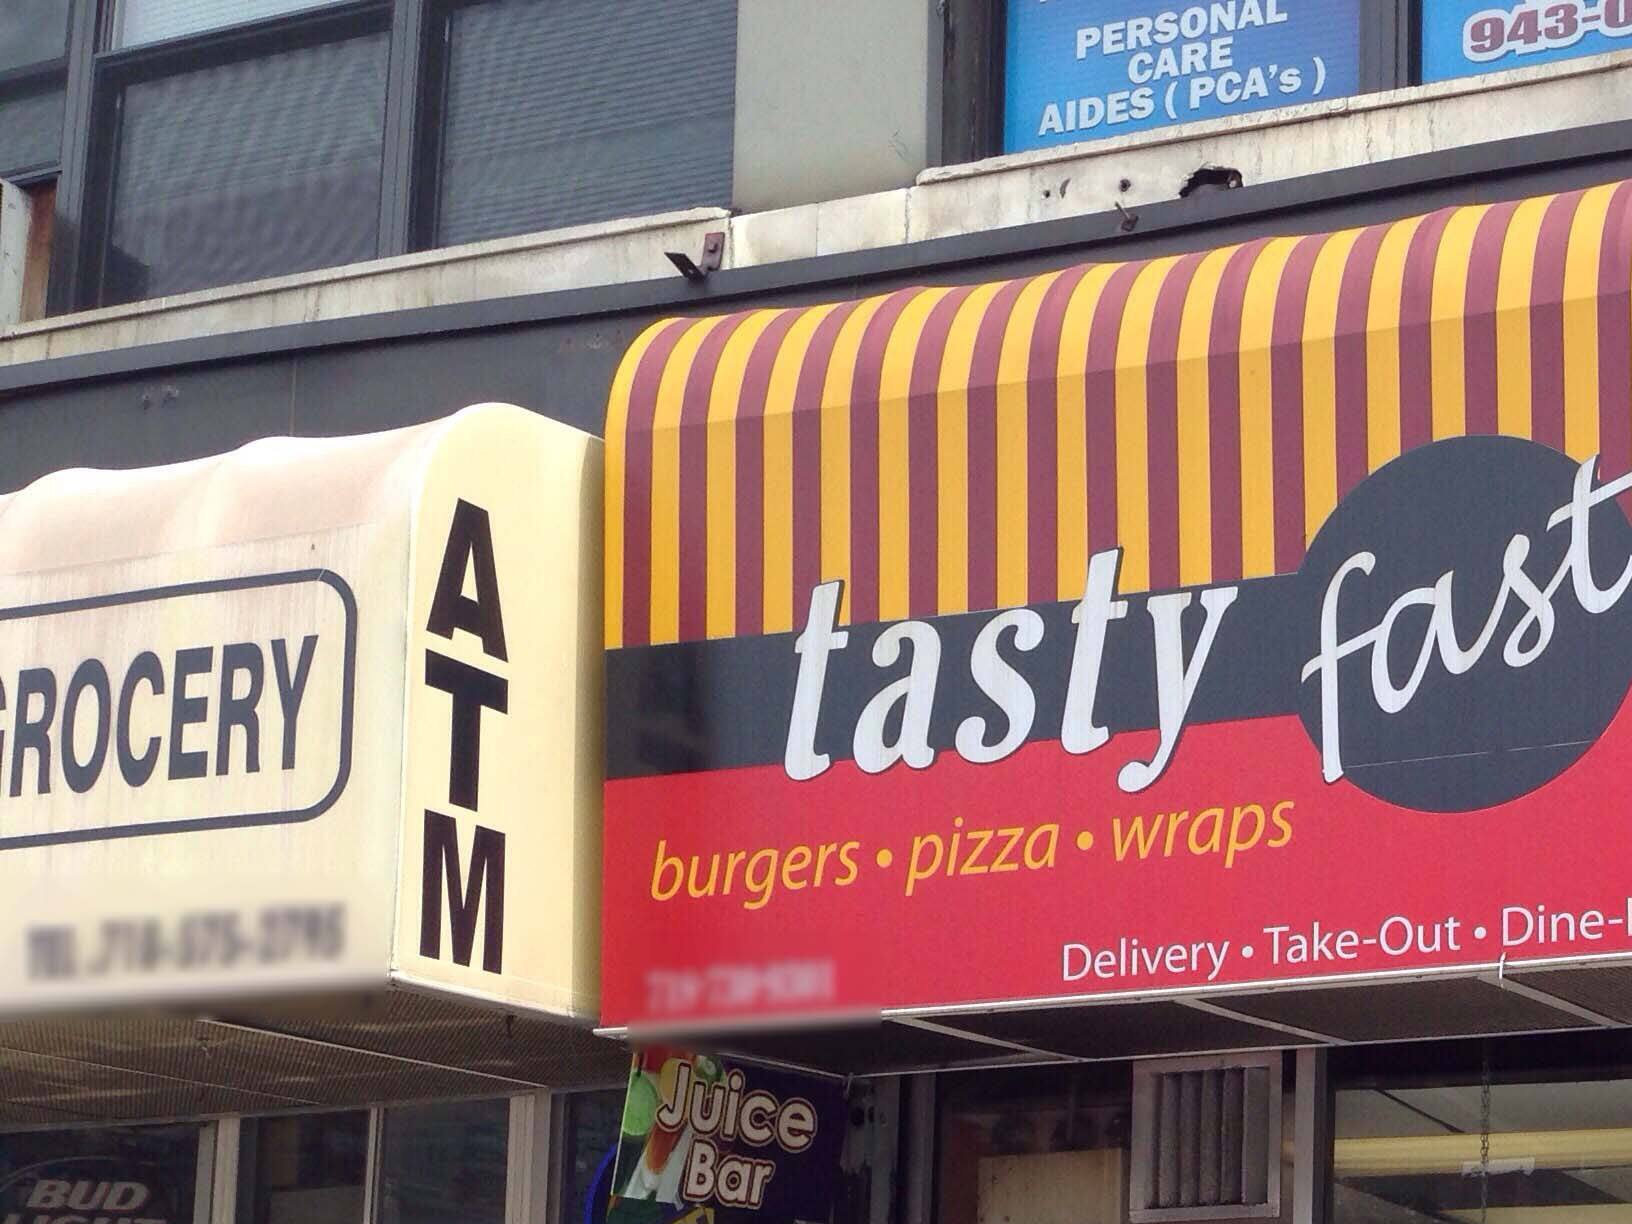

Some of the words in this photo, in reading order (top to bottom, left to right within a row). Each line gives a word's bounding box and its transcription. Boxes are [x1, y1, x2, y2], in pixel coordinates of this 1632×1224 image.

[1076, 0, 1288, 60] PERSONAL
[1127, 36, 1234, 84] CARE
[1037, 87, 1155, 136] AIDES
[783, 546, 1240, 794] tasty
[0, 633, 319, 798] ROCERY
[419, 497, 509, 975] ATM
[650, 839, 860, 910] burgers
[905, 817, 1059, 897] pizza
[1111, 799, 1295, 868] wraps
[1062, 937, 1230, 982] Delivery
[1263, 914, 1462, 966] Take-Out
[657, 1060, 817, 1153] Juice
[26, 1179, 149, 1211] BUD
[683, 1137, 777, 1210] Bar
